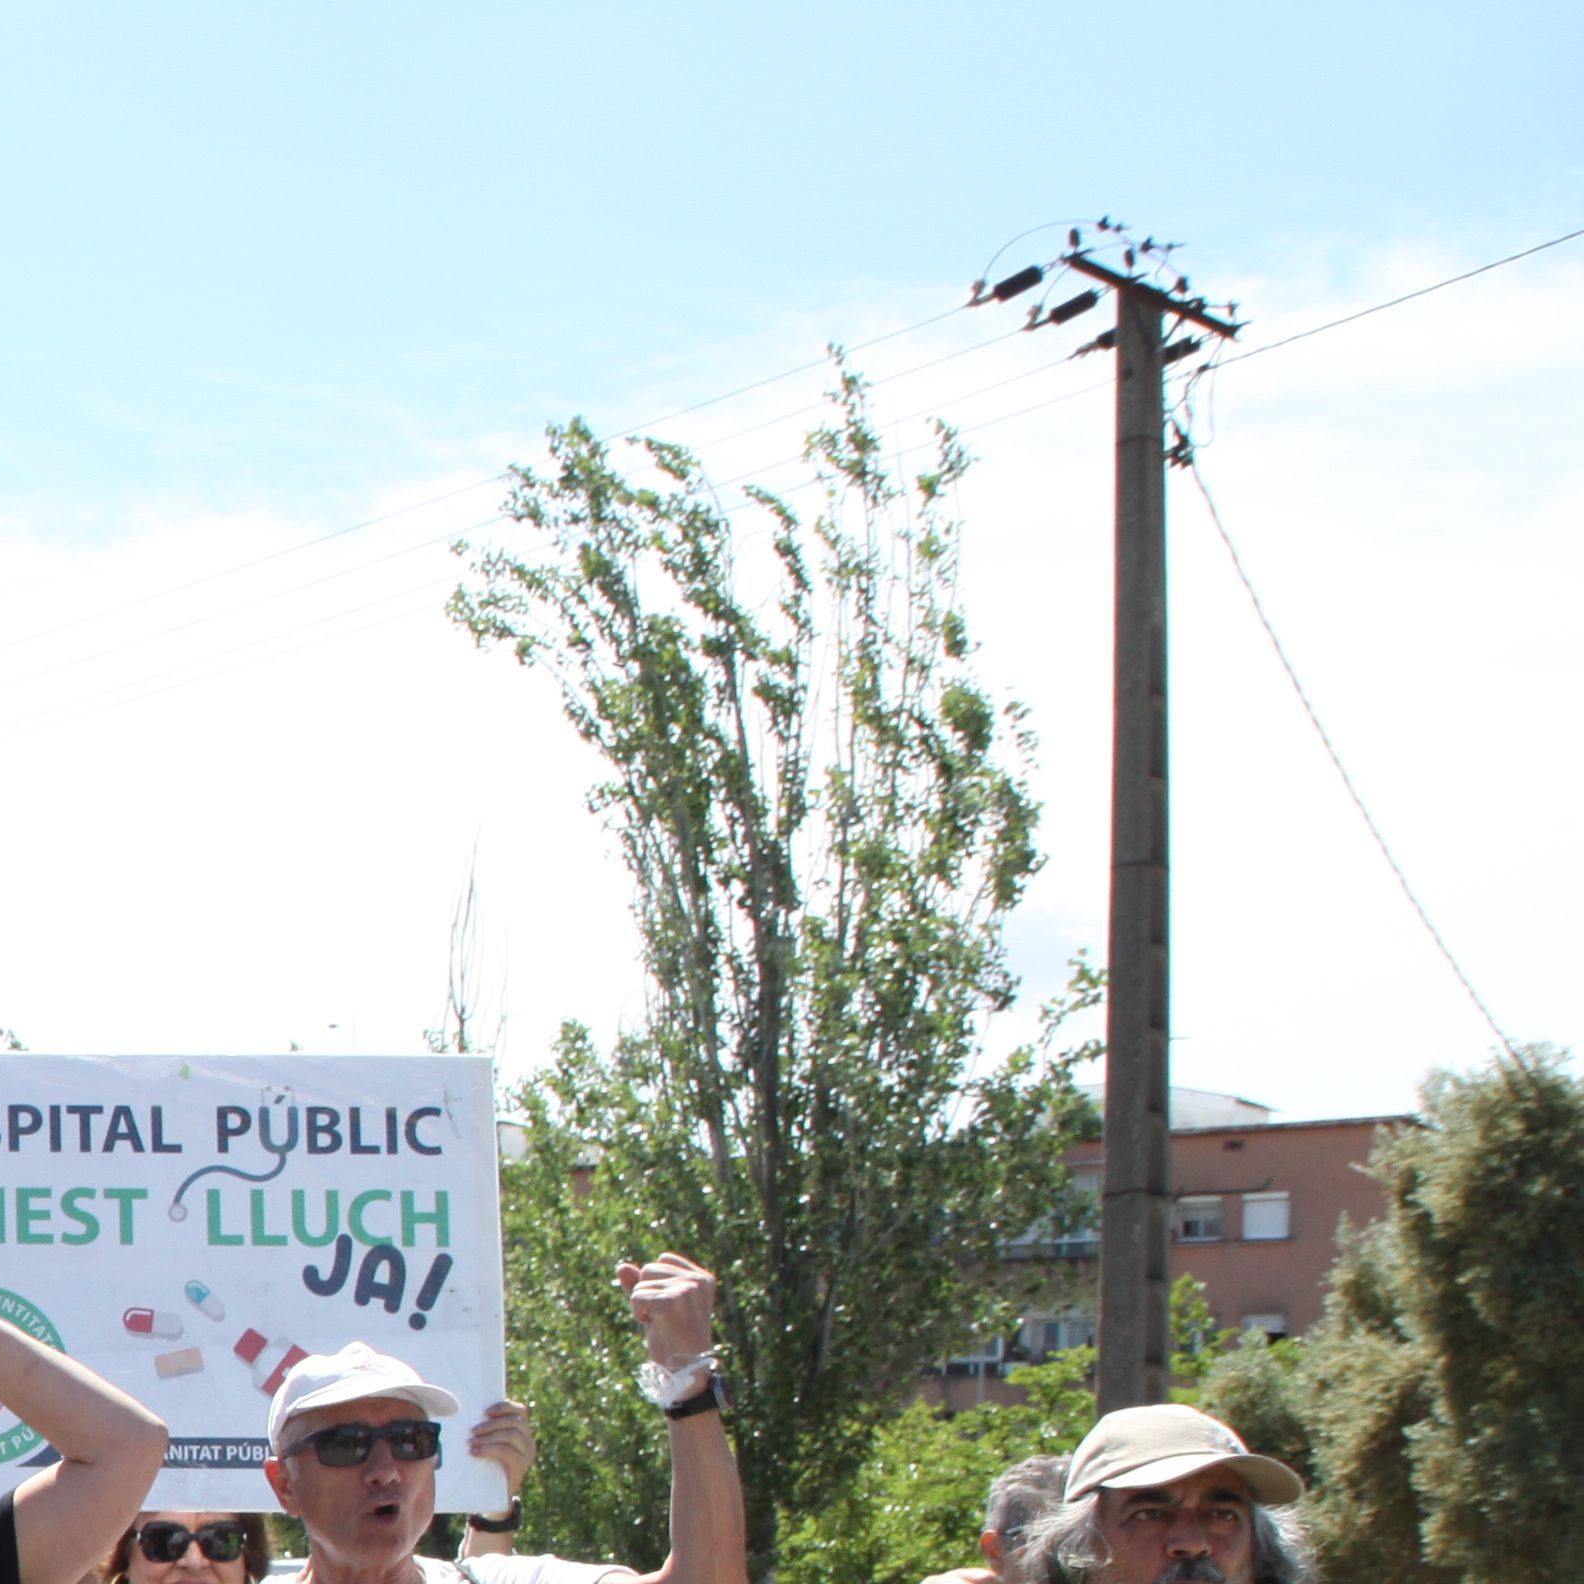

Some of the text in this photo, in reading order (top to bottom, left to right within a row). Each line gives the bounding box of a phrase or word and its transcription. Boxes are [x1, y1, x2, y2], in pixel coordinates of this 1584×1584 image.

[216, 1094, 443, 1156] PÚBLIC
[206, 1188, 451, 1248] LLUCH
[302, 1233, 454, 1331] JA!
[163, 1444, 222, 1461] NITAT
